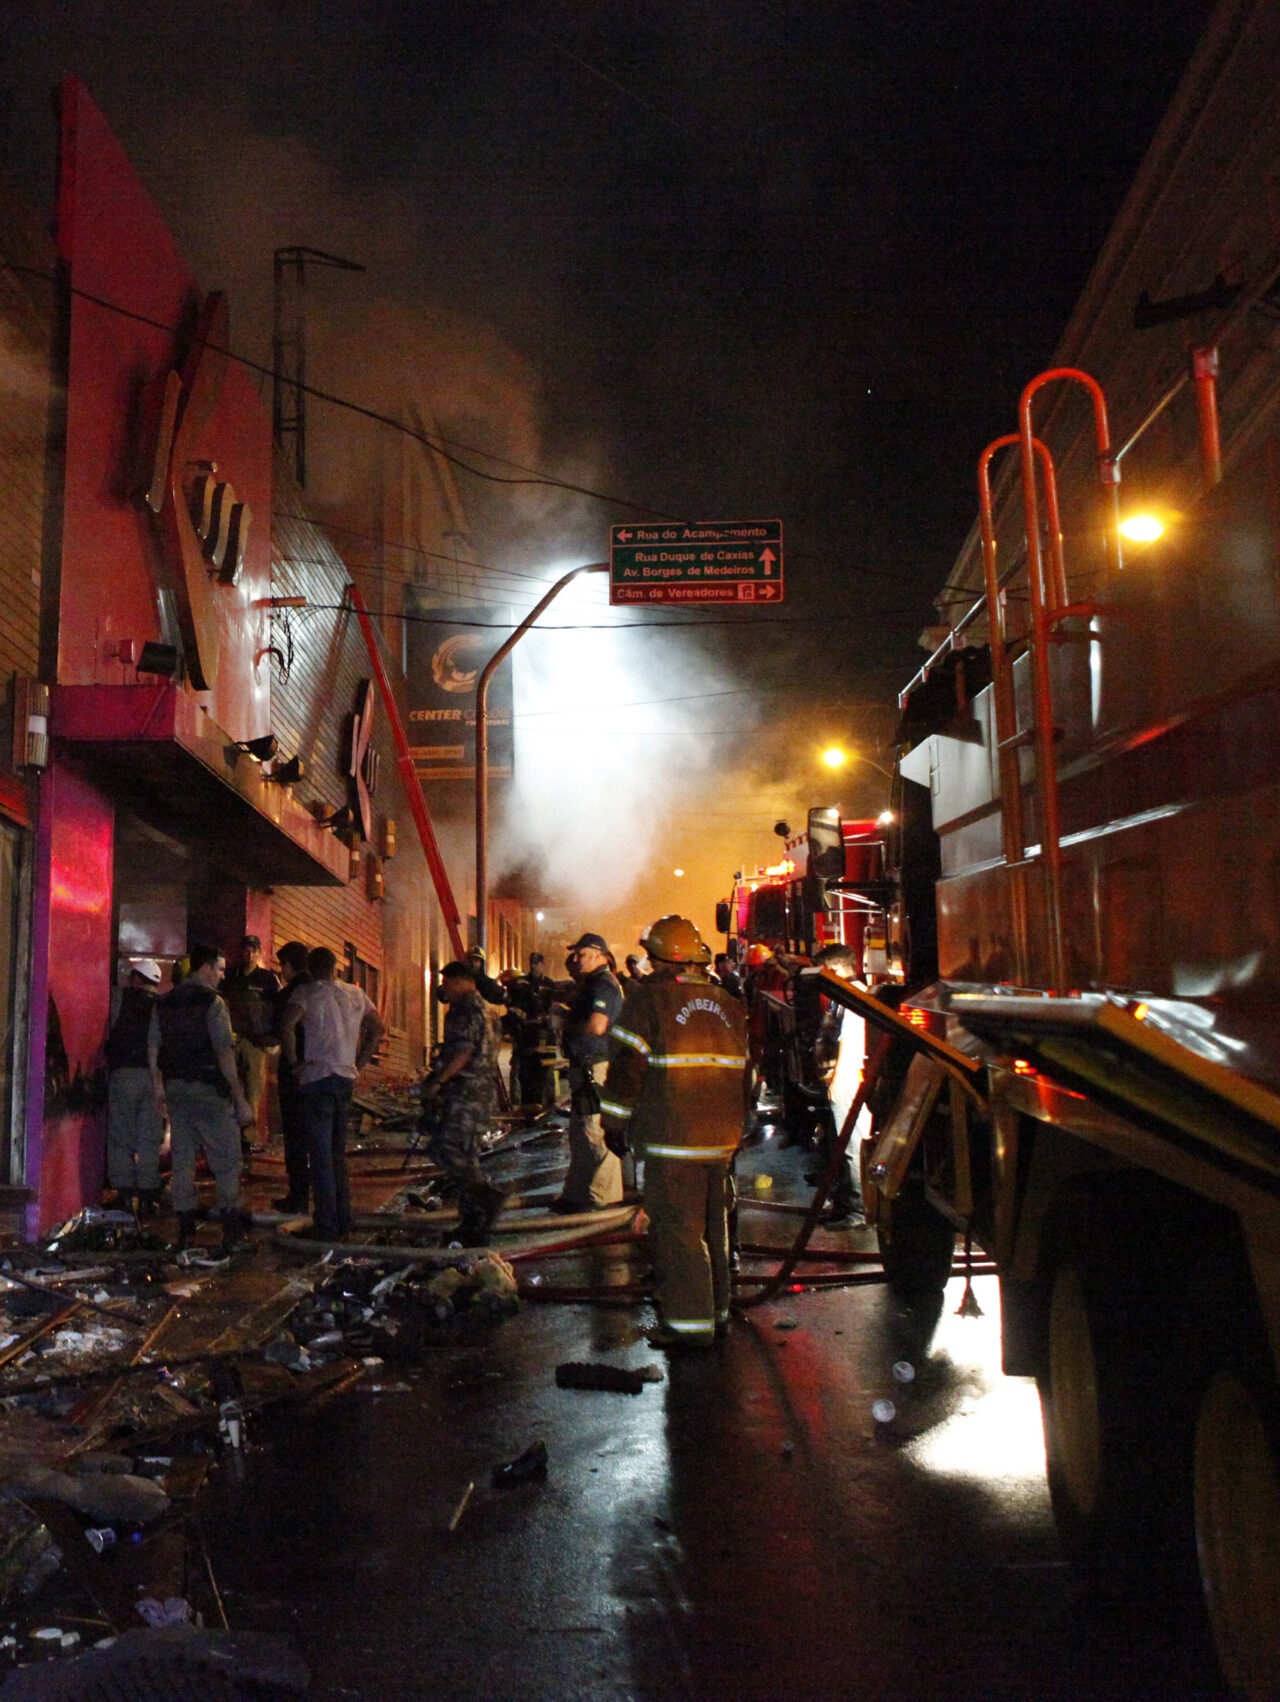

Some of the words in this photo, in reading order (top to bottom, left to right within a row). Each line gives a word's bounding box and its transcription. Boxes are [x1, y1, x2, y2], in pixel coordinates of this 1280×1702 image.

[637, 531, 658, 540] Rua
[662, 530, 677, 539] do
[682, 528, 768, 540] Acampmento
[635, 552, 657, 562] Rua
[660, 552, 696, 563] Duque
[700, 551, 714, 561] de
[717, 551, 755, 560] Caxias
[623, 568, 639, 577] Av.
[643, 567, 682, 578] Borges
[687, 566, 701, 575] de
[704, 565, 755, 575] Medeiros
[649, 588, 663, 598] de
[668, 587, 734, 598] Vereadores
[408, 709, 462, 721] CENTER
